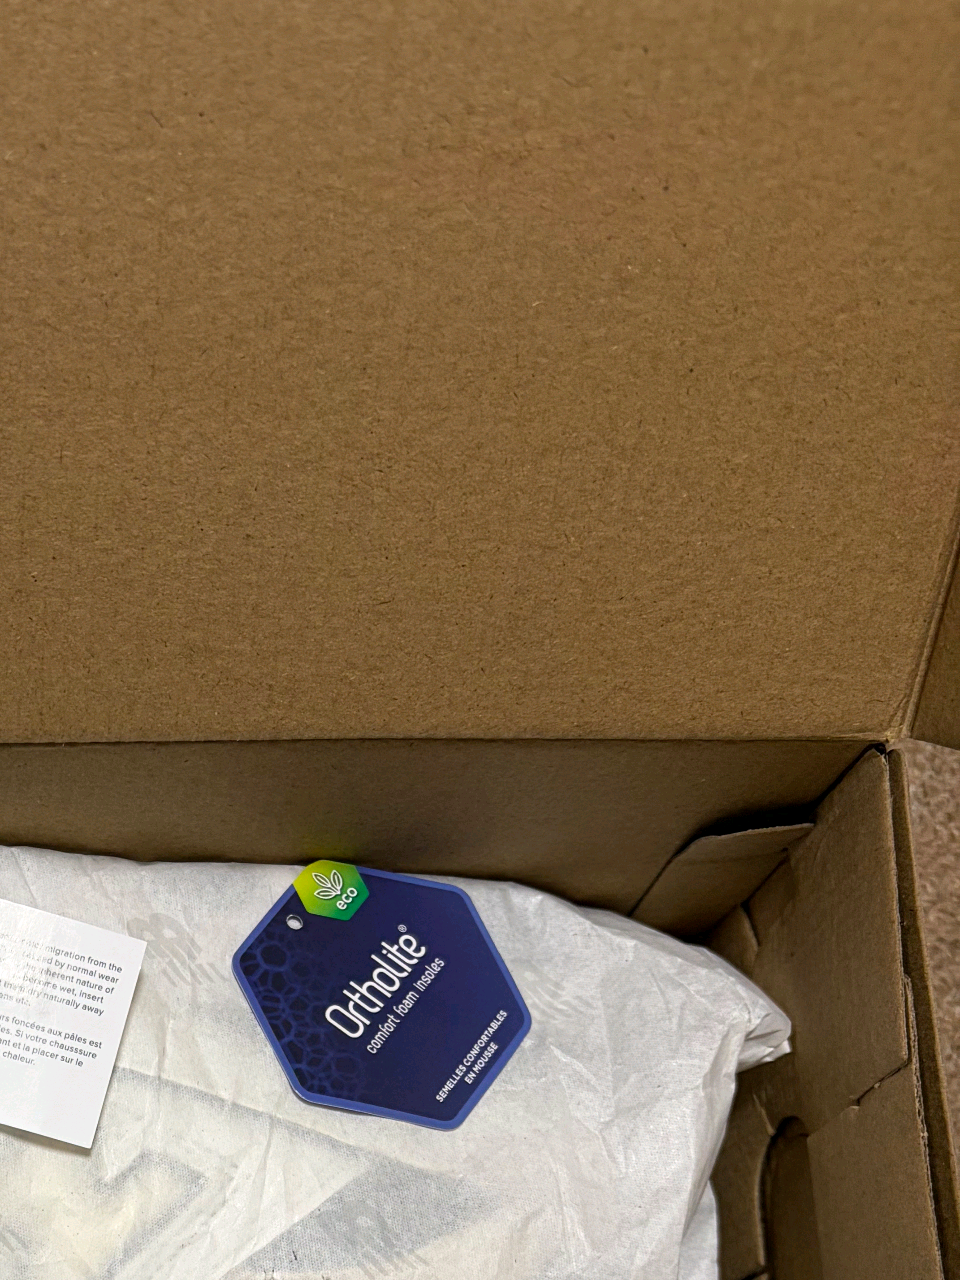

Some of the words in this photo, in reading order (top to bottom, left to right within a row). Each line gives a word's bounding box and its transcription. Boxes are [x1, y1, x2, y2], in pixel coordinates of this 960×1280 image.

[336, 887, 358, 910] eco
[44, 945, 86, 963] migration
[87, 956, 107, 969] from
[108, 962, 123, 973] the
[54, 959, 66, 970] by
[66, 963, 97, 978] normal
[97, 972, 120, 984] wear
[59, 985, 78, 996] wet,
[78, 989, 104, 1003] insert
[75, 977, 104, 991] nature
[104, 986, 115, 994] of
[27, 987, 43, 999] dry
[42, 992, 81, 1010] naturally
[81, 1004, 105, 1017] away
[366, 1015, 400, 1054] comfort
[396, 990, 419, 1017] foam
[417, 958, 445, 992] insoles
[11, 1016, 46, 1032] foncées
[46, 1028, 63, 1037] aux
[63, 1032, 88, 1045] pâles
[88, 1039, 103, 1049] est
[14, 1029, 24, 1038] Si
[25, 1033, 48, 1045] votre
[2, 1050, 36, 1066] chaleur.
[12, 1041, 22, 1050] et
[22, 1043, 31, 1052] la
[31, 1047, 60, 1061] placer
[59, 1055, 75, 1064] sur
[74, 1058, 84, 1067] le
[436, 1064, 466, 1103] SEMELLES
[463, 1009, 508, 1067] CONFORTABLES
[464, 1070, 476, 1085] EN
[472, 1041, 499, 1074] MOUSSE
